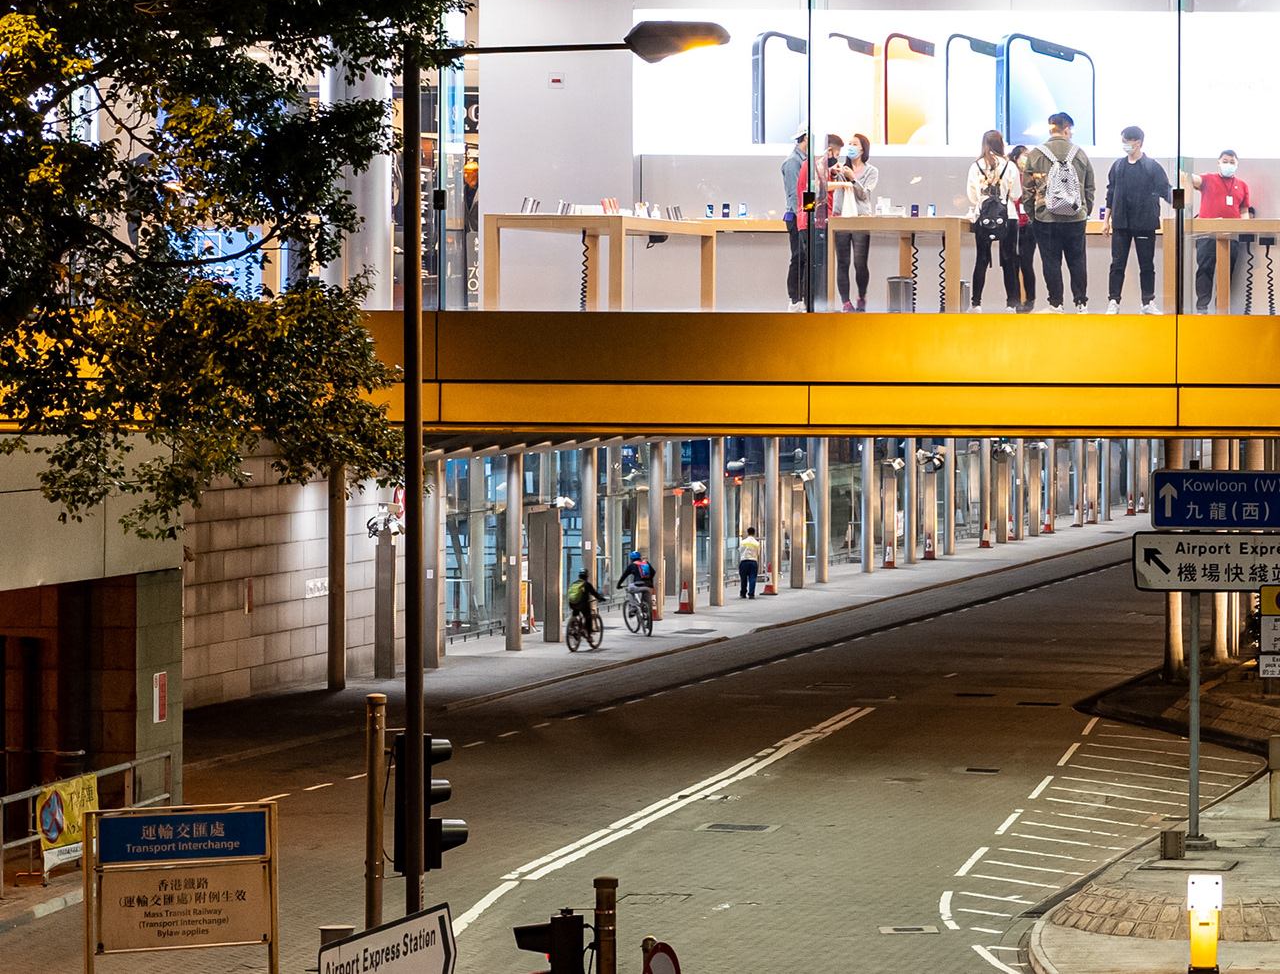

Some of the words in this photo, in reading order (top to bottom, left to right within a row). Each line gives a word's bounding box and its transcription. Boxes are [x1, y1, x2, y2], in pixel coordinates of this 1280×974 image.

[1183, 479, 1247, 492] Kowloon
[1186, 501, 1270, 521] 九龍(西)
[1175, 542, 1231, 557] Airport
[140, 821, 225, 840] 運輸交匯處
[126, 842, 175, 854] Transport
[178, 839, 240, 852] Interchange
[157, 878, 209, 891] 香港鐵路
[144, 910, 162, 919] Mass
[164, 909, 191, 918] Transit
[192, 907, 222, 918] Railway
[138, 919, 178, 931] (Transport
[180, 916, 229, 928] Interchange)
[157, 929, 180, 938] Bylaw
[181, 928, 209, 938] applies
[362, 943, 401, 972] Express
[402, 928, 436, 957] Station
